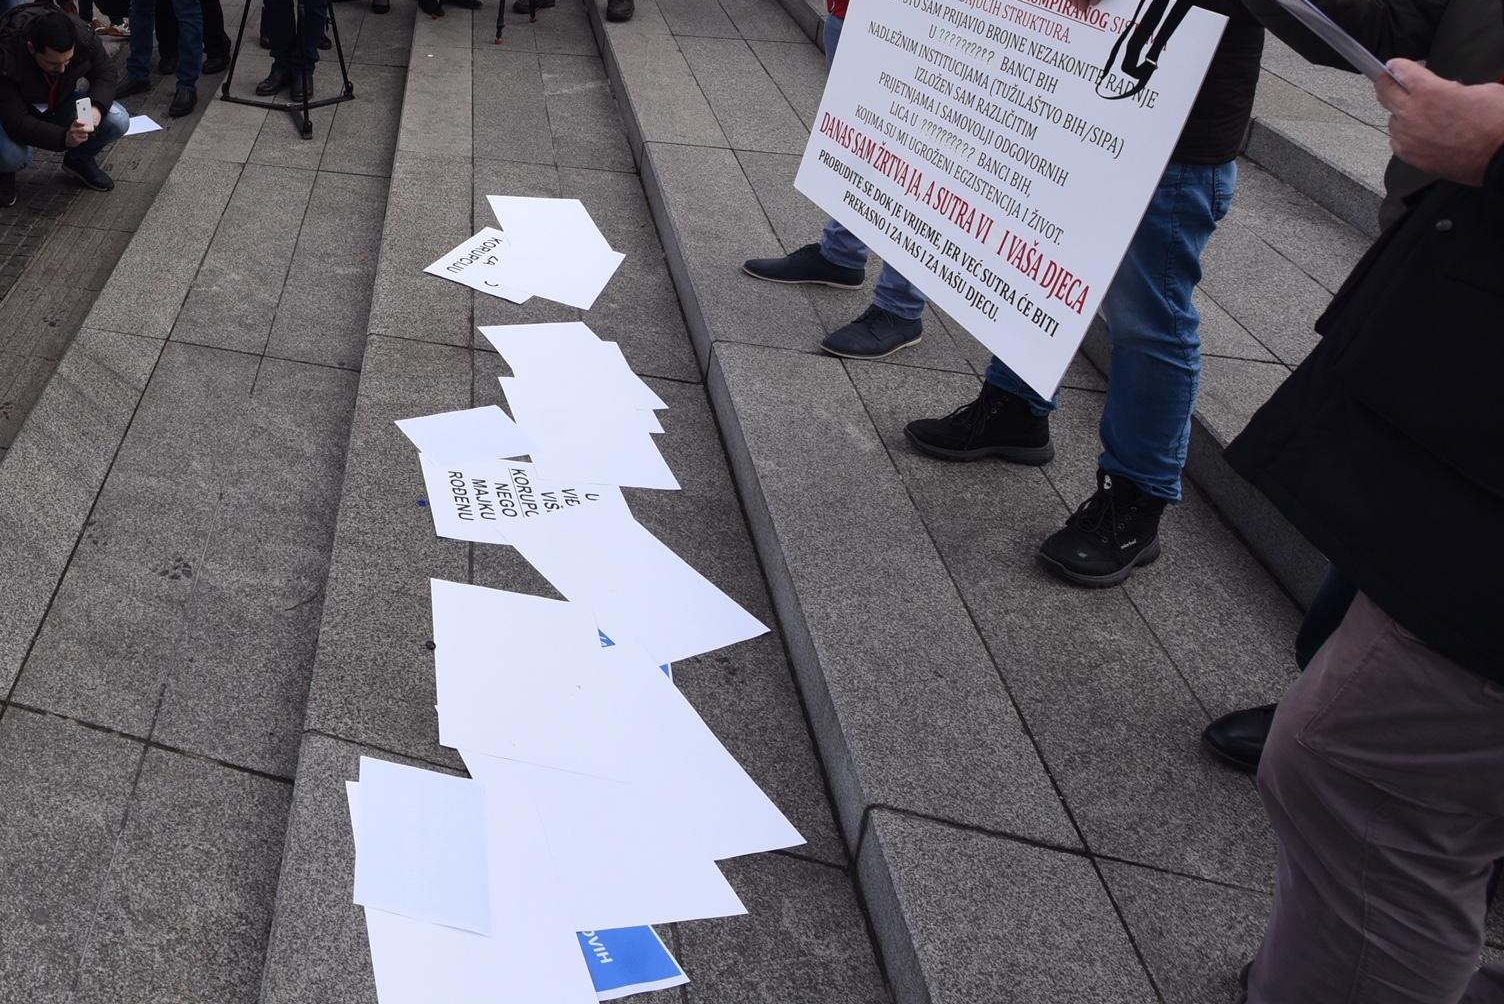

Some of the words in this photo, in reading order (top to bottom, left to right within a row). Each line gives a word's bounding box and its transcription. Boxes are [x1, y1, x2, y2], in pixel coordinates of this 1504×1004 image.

[928, 24, 938, 39] U
[1000, 56, 1035, 83] BANCI
[1035, 71, 1059, 94] BIH
[942, 6, 985, 35] PRIJAVIO
[985, 23, 1028, 52] BROJNE
[1027, 40, 1106, 86] NEZAKONITE
[1002, 4, 1071, 44] STRUKTURA.
[868, 21, 918, 55] NADLEŽNIM
[918, 43, 990, 90] INSTITUCIJAMA
[989, 78, 1063, 124] (TUŽILAŠTVO
[1062, 113, 1125, 159] BIH/SIPA)
[914, 66, 954, 96] IZLOŽEN
[953, 86, 977, 108] SAM
[975, 97, 1038, 141] RAZLIČITIM
[879, 71, 935, 113] PRIJETNJAMA
[936, 102, 941, 115] I
[940, 105, 995, 146] SAMOVOLJI
[994, 134, 1069, 187] ODGOVORNIH
[889, 101, 910, 123] LICA
[910, 113, 918, 127] U
[977, 152, 1011, 182] BANCI
[1010, 171, 1032, 198] BIH,
[819, 112, 855, 149] DANAS
[851, 133, 877, 164] SAM
[873, 141, 910, 187] ŽRTVA
[904, 168, 923, 201] JA,
[922, 181, 936, 205] A
[932, 186, 976, 234] SUTRA
[975, 213, 994, 244] VI
[996, 230, 1010, 256] I
[1006, 240, 1044, 282] VAŠA
[1039, 259, 1090, 315] DJECA
[855, 104, 884, 132] KOJIMA
[884, 122, 897, 138] SU
[896, 129, 909, 147] MI
[909, 133, 955, 175] UGROŽENI
[953, 163, 1022, 219] EGZISTENCIJA
[1021, 208, 1029, 222] I
[1027, 209, 1064, 246] ŽIVOT.
[446, 237, 503, 273] KORUPCIJU
[818, 149, 864, 189] PROBUDITE
[862, 180, 874, 197] SE
[873, 188, 894, 212] DOK
[890, 201, 904, 219] JE
[903, 209, 942, 251] VRIJEME,
[941, 239, 961, 262] JER
[962, 252, 983, 278] VEĆ
[980, 268, 1017, 306] SUTRA
[1016, 293, 1034, 317] ĆE
[1031, 307, 1060, 338] BITI
[843, 190, 886, 231] PREKASNO
[884, 223, 891, 235] I
[889, 225, 902, 245] ZA
[901, 235, 922, 259] NAS
[920, 250, 927, 262] I
[925, 253, 939, 274] ZA
[938, 264, 967, 294] NAŠU
[964, 285, 1000, 322] DJECU.
[448, 470, 475, 521] ROĐENU
[471, 478, 496, 520] MAJKU
[494, 482, 518, 517] NEGO
[541, 491, 564, 513] VIŠ
